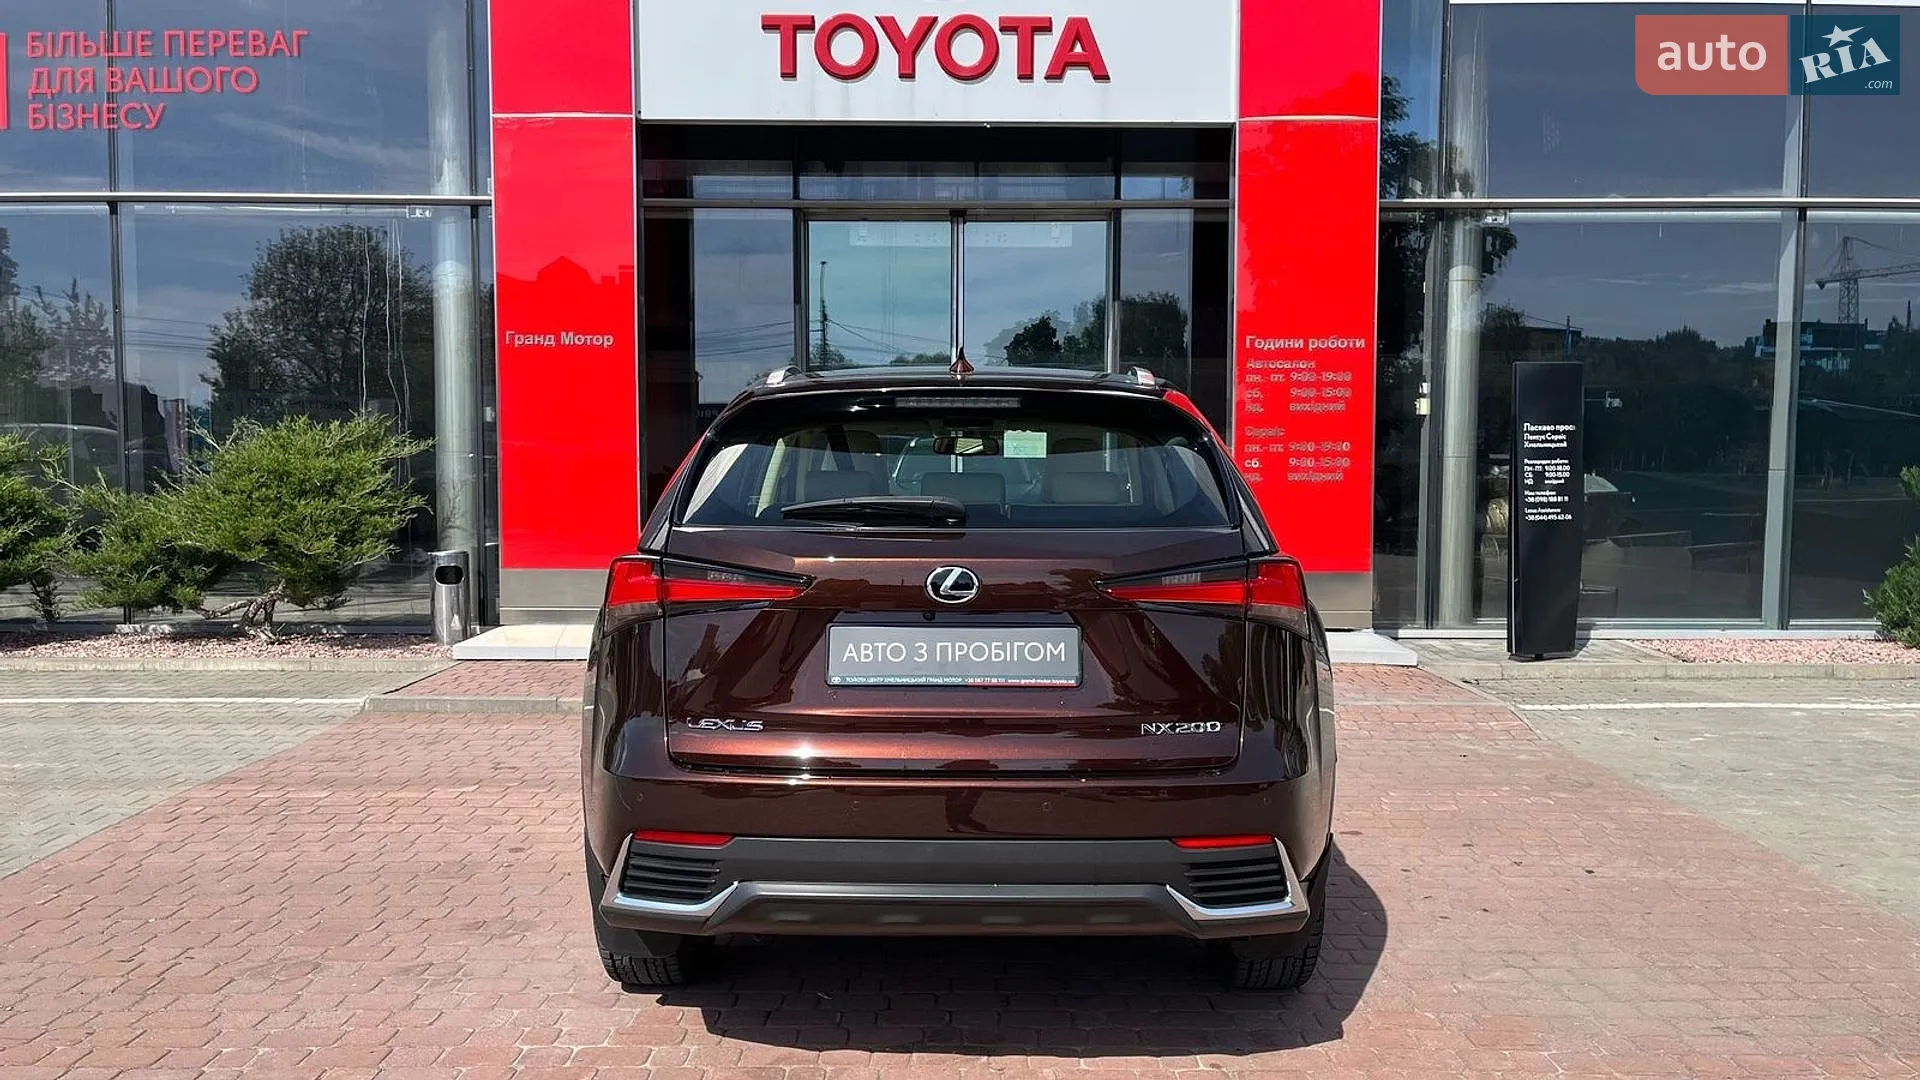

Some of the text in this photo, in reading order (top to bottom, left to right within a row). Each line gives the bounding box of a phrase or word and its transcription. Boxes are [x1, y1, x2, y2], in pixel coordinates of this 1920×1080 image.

[26, 29, 309, 58] БІЛЬШЕ ПЕРЕВАГ
[761, 13, 1111, 81] TOYOTA
[27, 66, 259, 99] ДЛЯ ВАШОГО
[27, 103, 166, 130] БІЗНЕСУ
[505, 330, 614, 349] Гранд Мотор
[1245, 334, 1366, 351] Години роботи
[1246, 359, 1317, 370] Автосалон
[841, 642, 907, 662] АВТО
[936, 642, 1065, 662] ПРОБІГОМ
[686, 717, 764, 731] LEXUS
